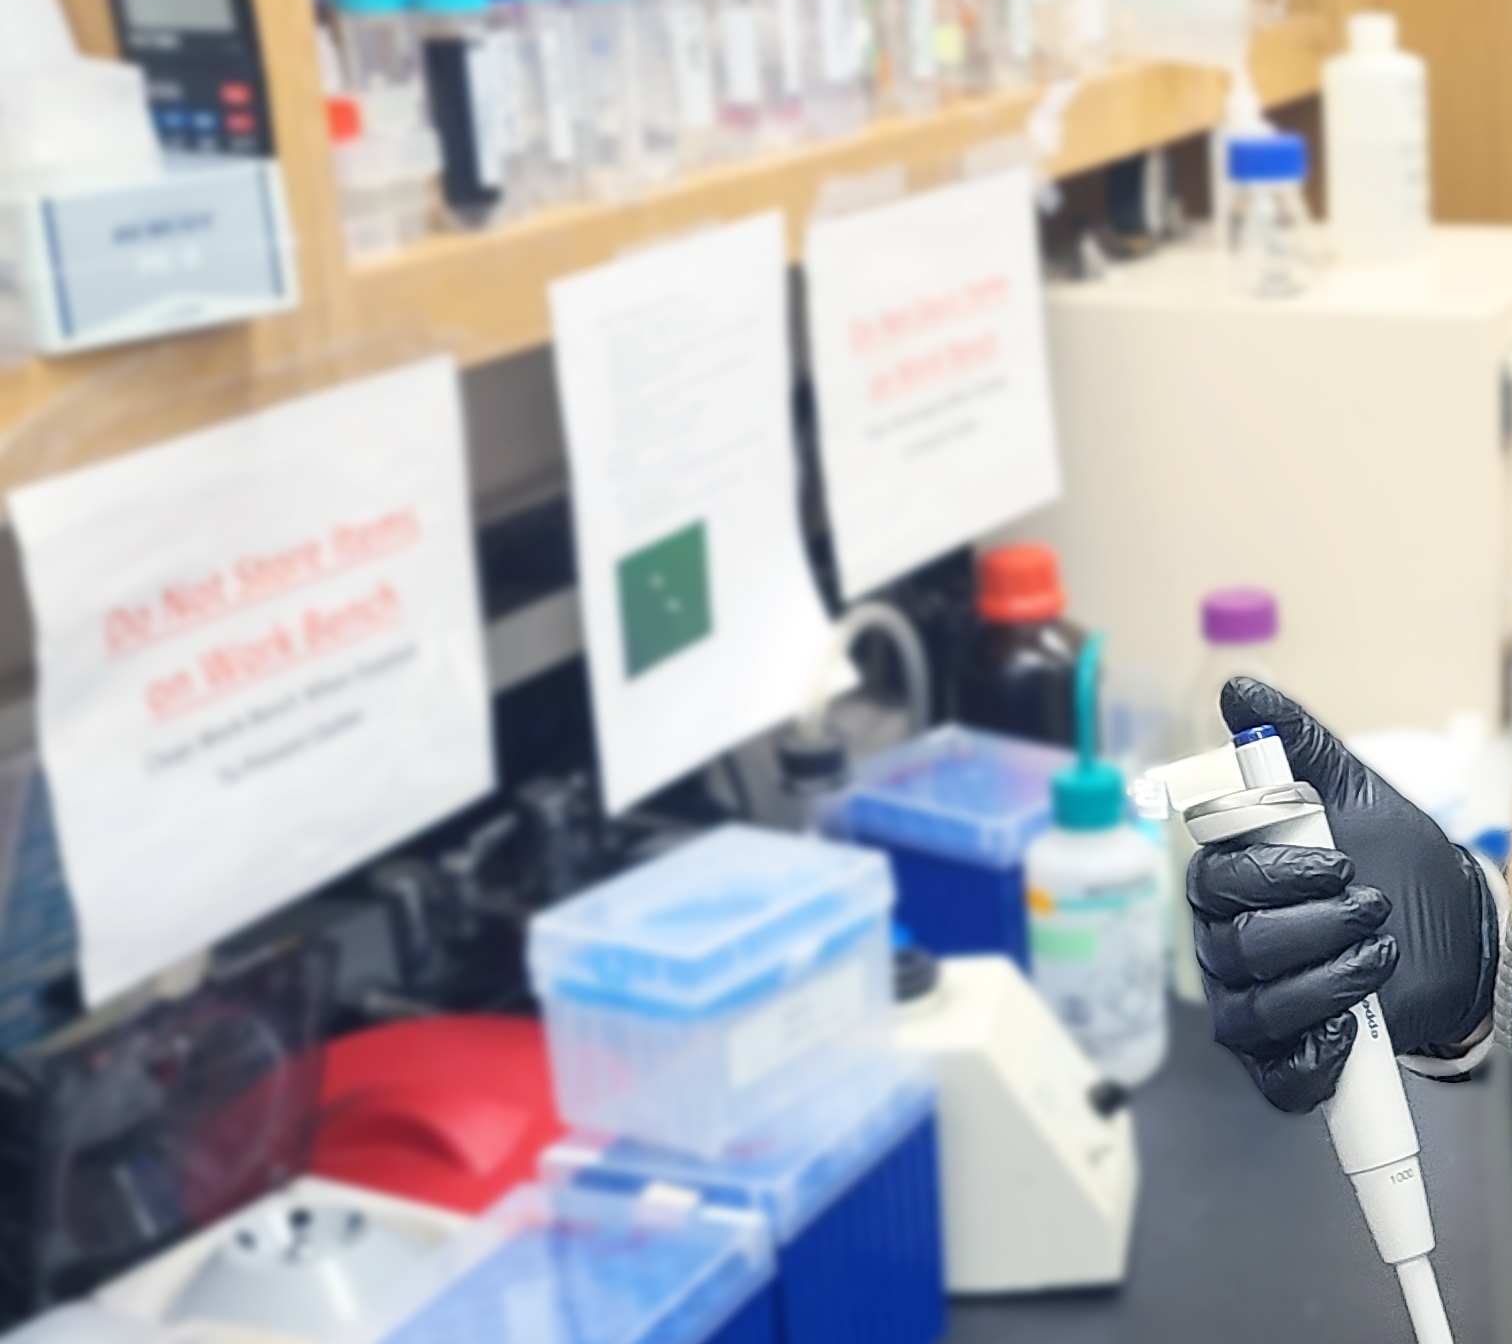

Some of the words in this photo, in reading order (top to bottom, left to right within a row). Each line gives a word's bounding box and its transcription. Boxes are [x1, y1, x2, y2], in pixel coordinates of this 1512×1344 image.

[104, 607, 152, 653] Do
[160, 572, 226, 620] Not
[233, 540, 323, 596] Store
[329, 506, 421, 560] Items
[145, 670, 194, 717] on
[200, 622, 294, 689] Work
[301, 580, 400, 650] Bench
[1390, 1168, 1414, 1185] 1000
